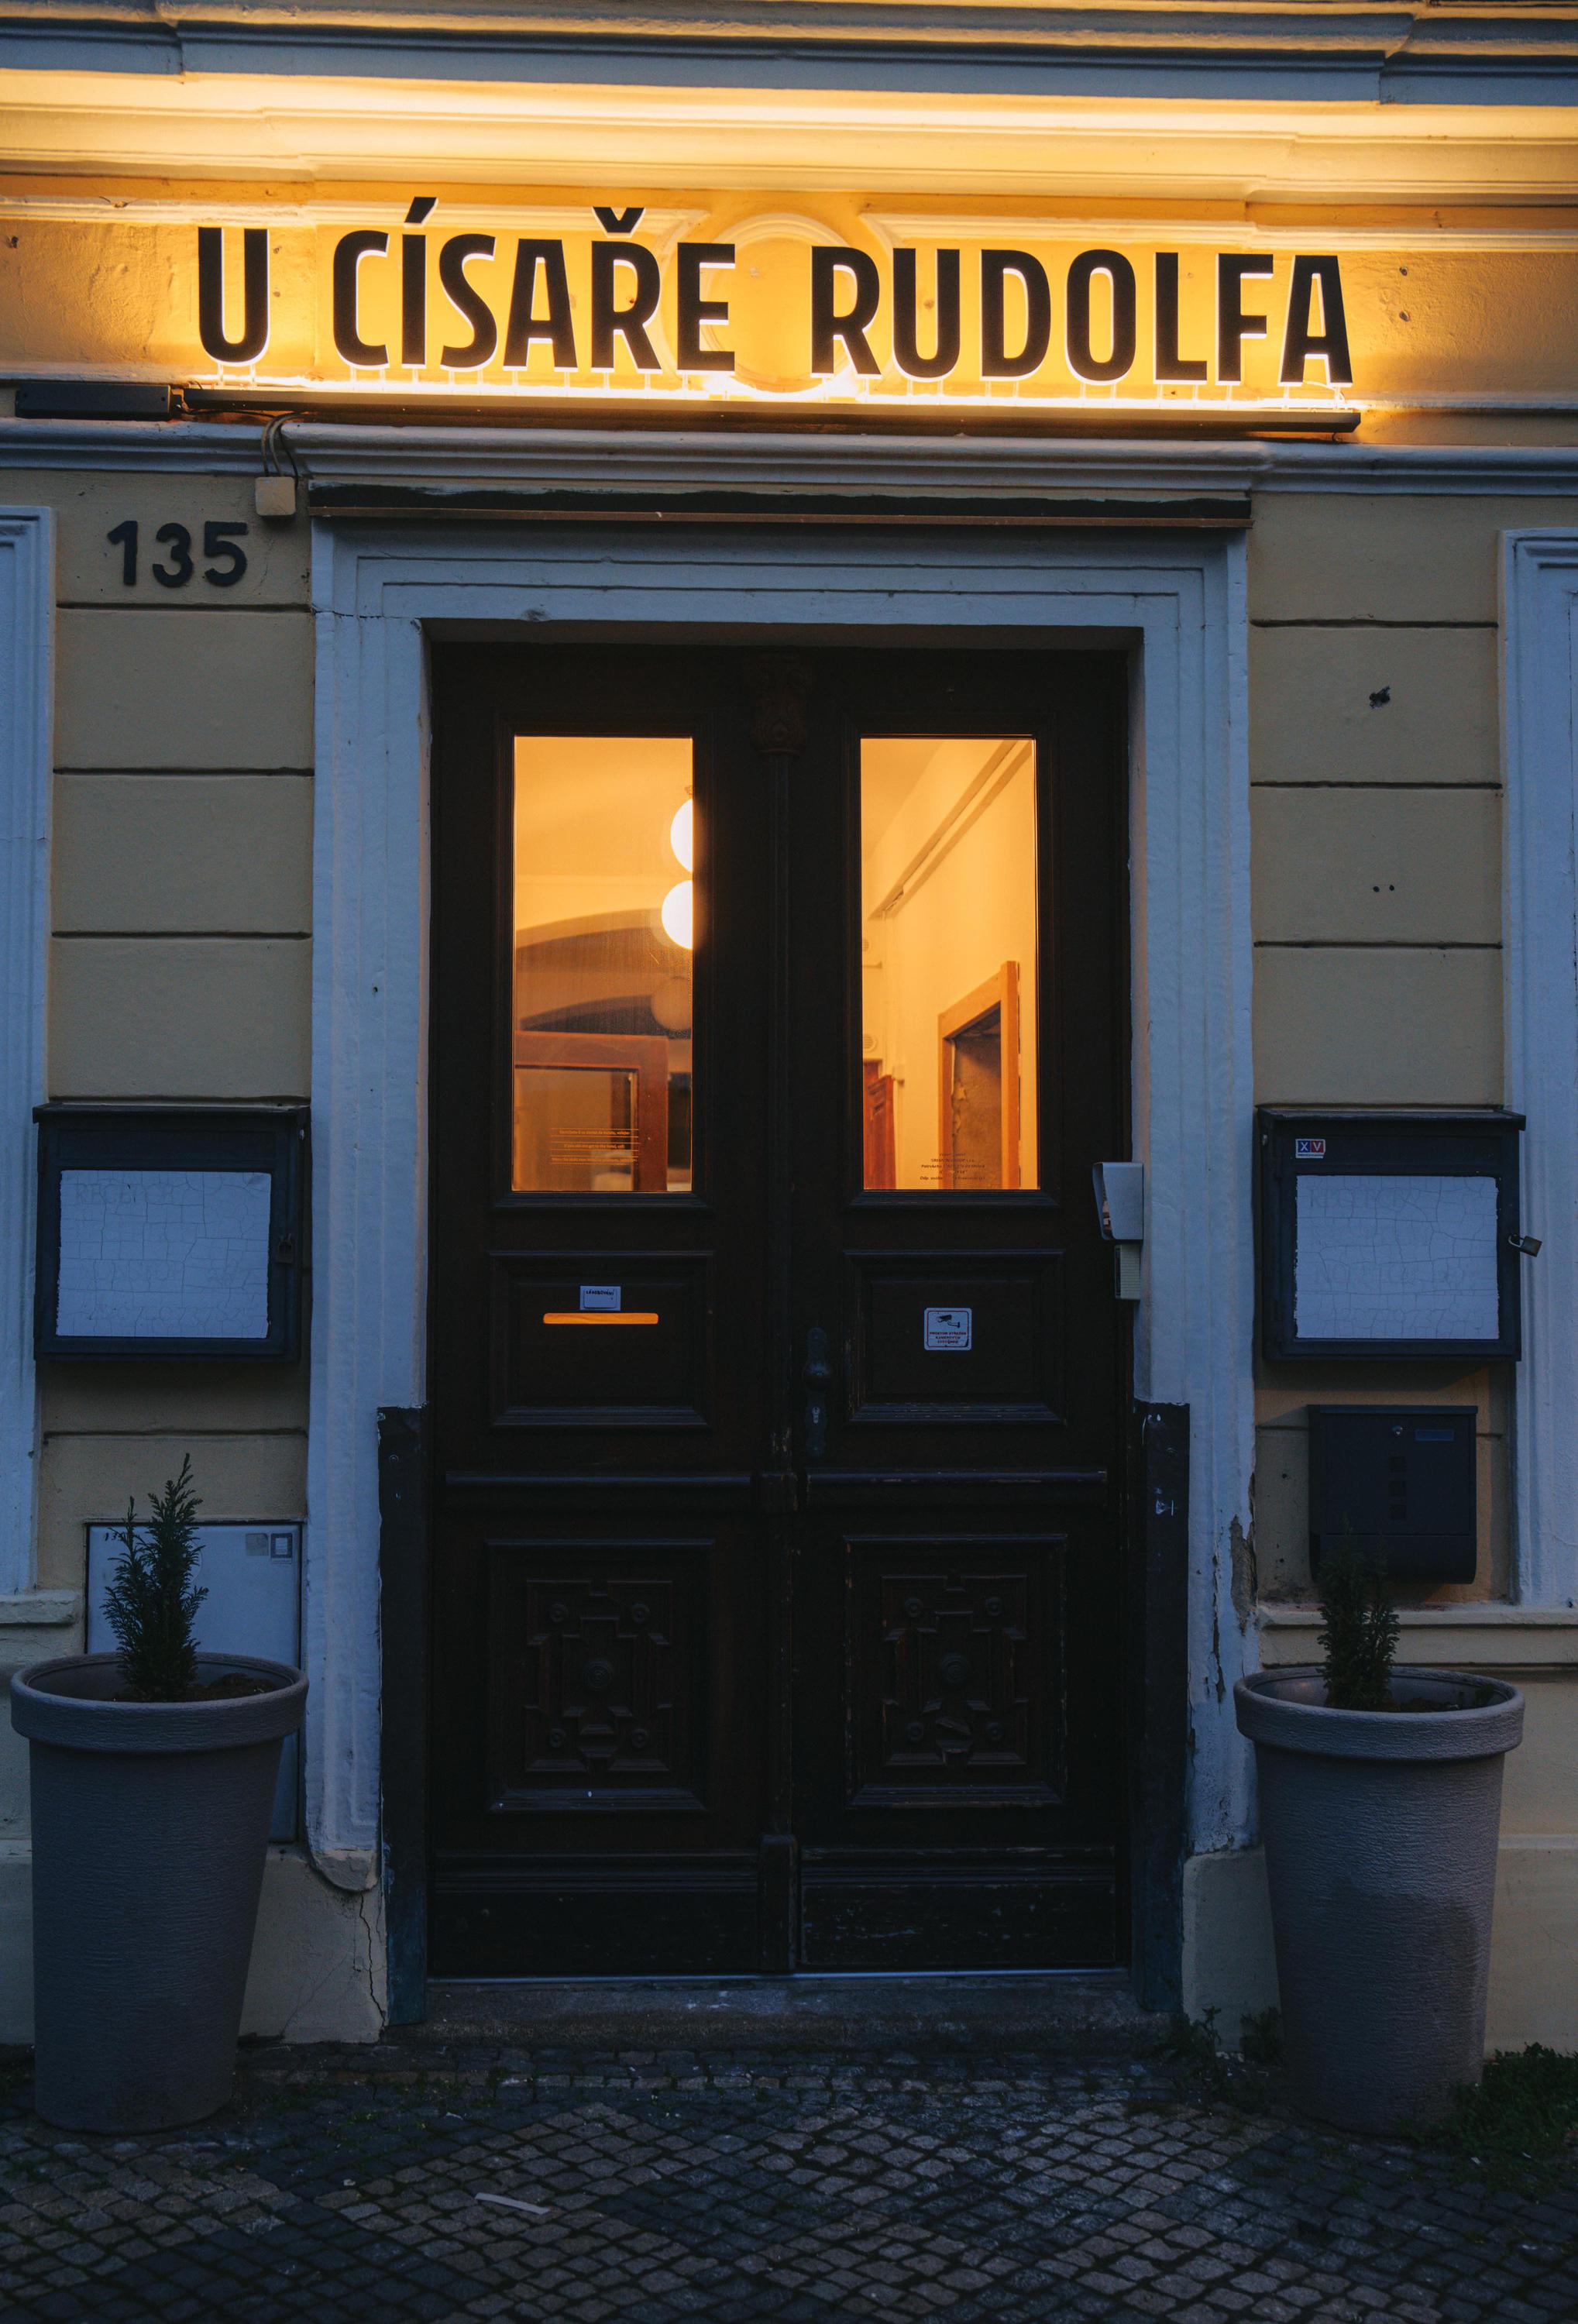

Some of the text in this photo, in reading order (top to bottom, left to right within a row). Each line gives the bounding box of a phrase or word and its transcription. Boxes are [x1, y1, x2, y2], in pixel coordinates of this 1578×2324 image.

[198, 196, 1353, 383] U CÍSAŘE RUDOLFA
[107, 520, 249, 588] 135
